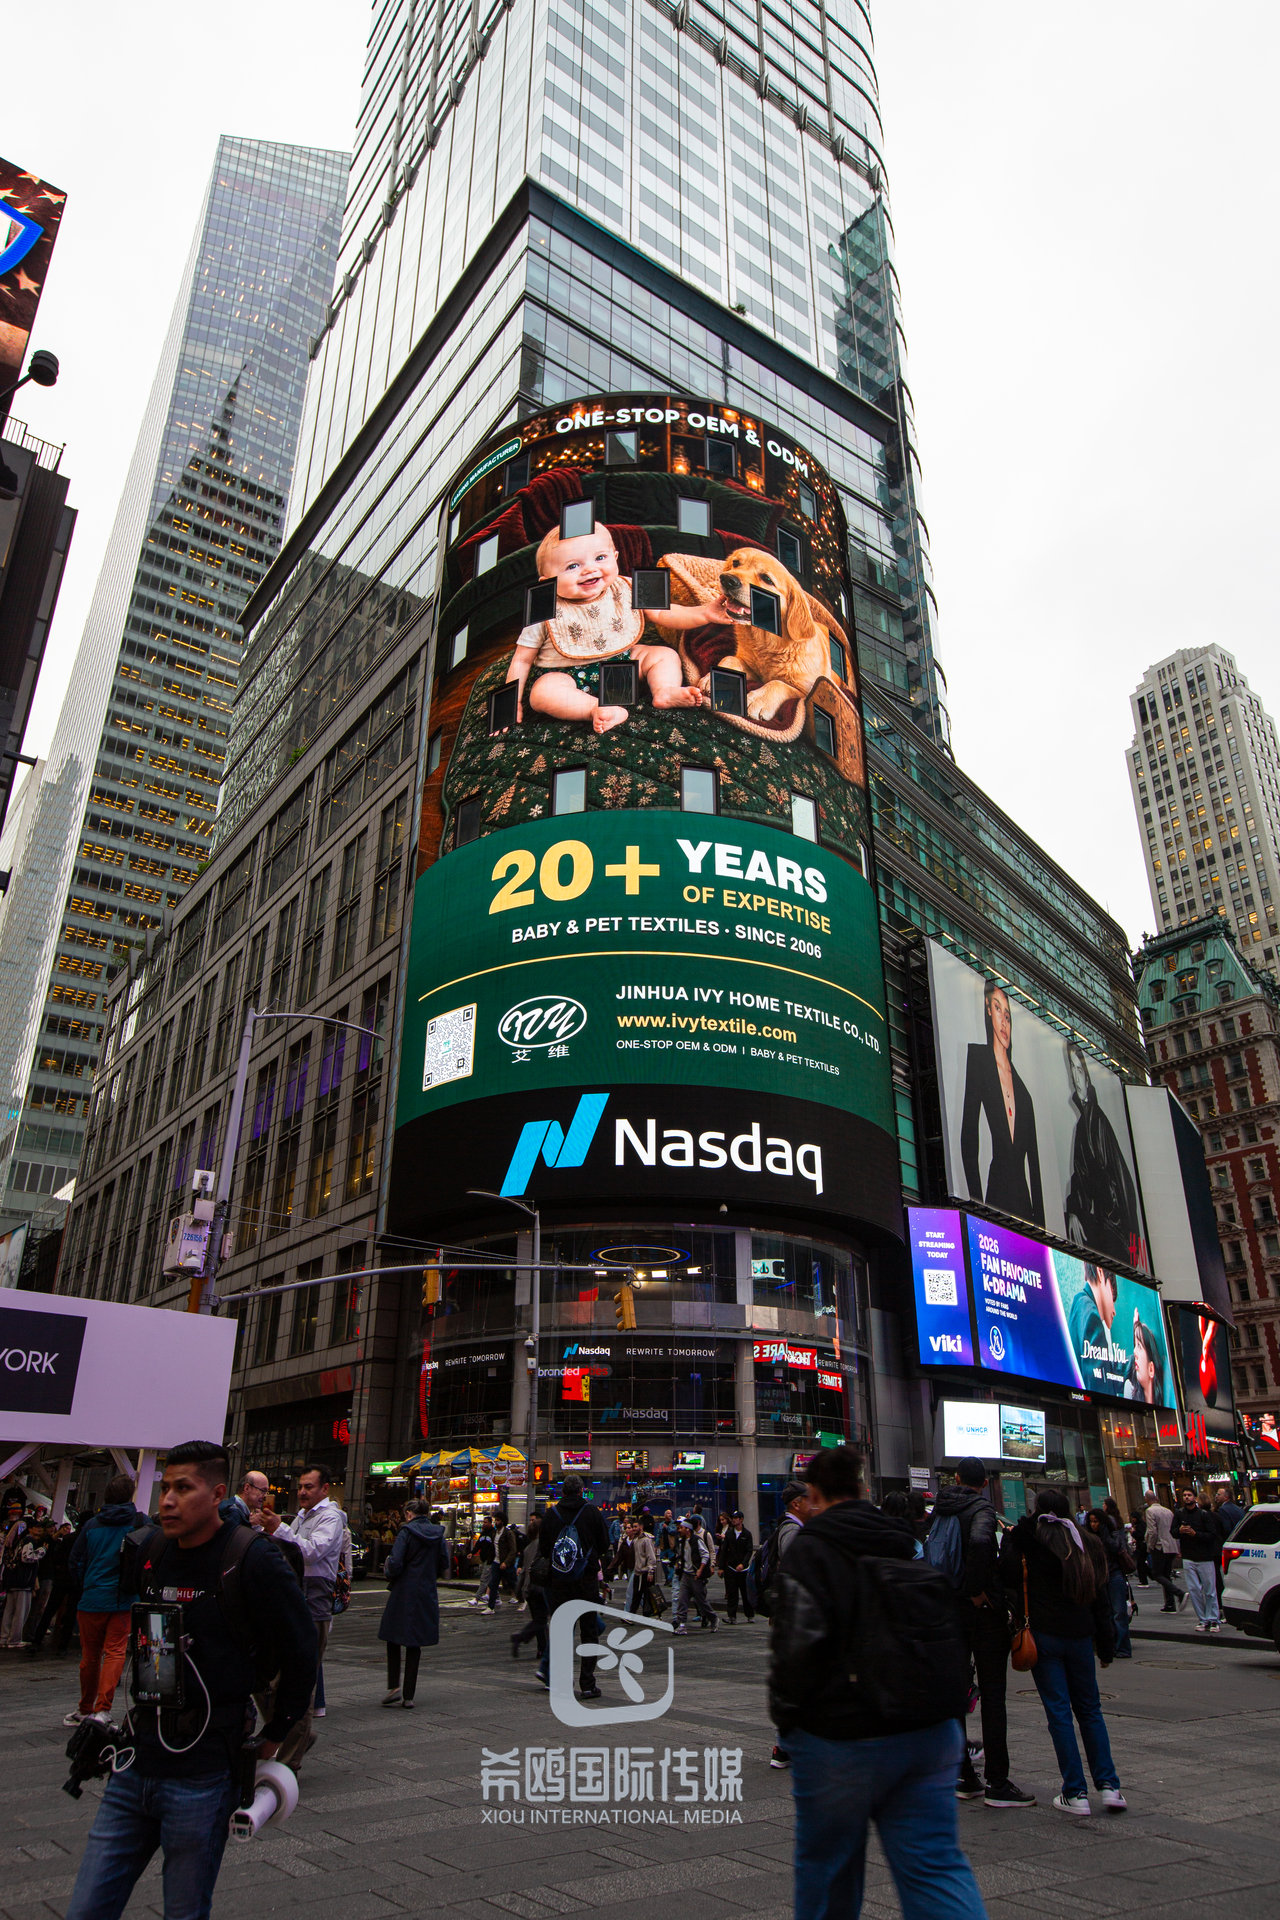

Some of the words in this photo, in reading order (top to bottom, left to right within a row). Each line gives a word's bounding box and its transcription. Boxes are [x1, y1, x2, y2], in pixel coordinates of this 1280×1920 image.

[556, 408, 680, 433] ONE-STOP
[687, 413, 739, 438] OEM
[745, 430, 761, 448] &
[767, 440, 808, 478] ODM
[470, 443, 519, 483] MANUFACTURER
[676, 838, 828, 903] YEARS
[682, 885, 715, 903] OF
[723, 890, 832, 935] EXPERTISE
[512, 921, 561, 943] BABY
[566, 920, 580, 934] &
[585, 917, 623, 932] PET
[628, 917, 720, 936] TEXTILES
[735, 925, 787, 948] SINCE
[790, 938, 822, 959] 2006
[616, 985, 688, 1000] JINHUA
[694, 987, 724, 1003] IVY
[729, 991, 781, 1012] HOME
[784, 1000, 841, 1030] TEXTILE
[843, 1021, 864, 1044] CO.,
[865, 1032, 882, 1054] LTD.
[617, 1013, 797, 1043] www.ivytextile.com
[616, 1039, 673, 1049] ONE-STOP
[675, 1041, 700, 1051] OEM
[703, 1042, 710, 1051] &
[713, 1043, 737, 1054] ODM
[750, 1047, 776, 1060] BABY
[778, 1052, 784, 1061] &
[786, 1053, 803, 1065] PET
[804, 1057, 840, 1075] TEXTILES
[615, 1118, 824, 1195] Nasdaq
[918, 1241, 956, 1249] STREAMING
[925, 1231, 945, 1239] START
[978, 1233, 1000, 1255] 2026
[980, 1252, 1000, 1275] FAN
[1000, 1259, 1043, 1290] FAVORITE
[982, 1273, 1027, 1304] K-DRAMA
[578, 1346, 611, 1356] Nasdaq
[626, 1347, 664, 1356] REWRITE
[667, 1348, 716, 1357] TOMORROW
[1081, 1340, 1108, 1361] Dream
[1112, 1342, 1129, 1363] You
[623, 1407, 669, 1421] Nasdaq
